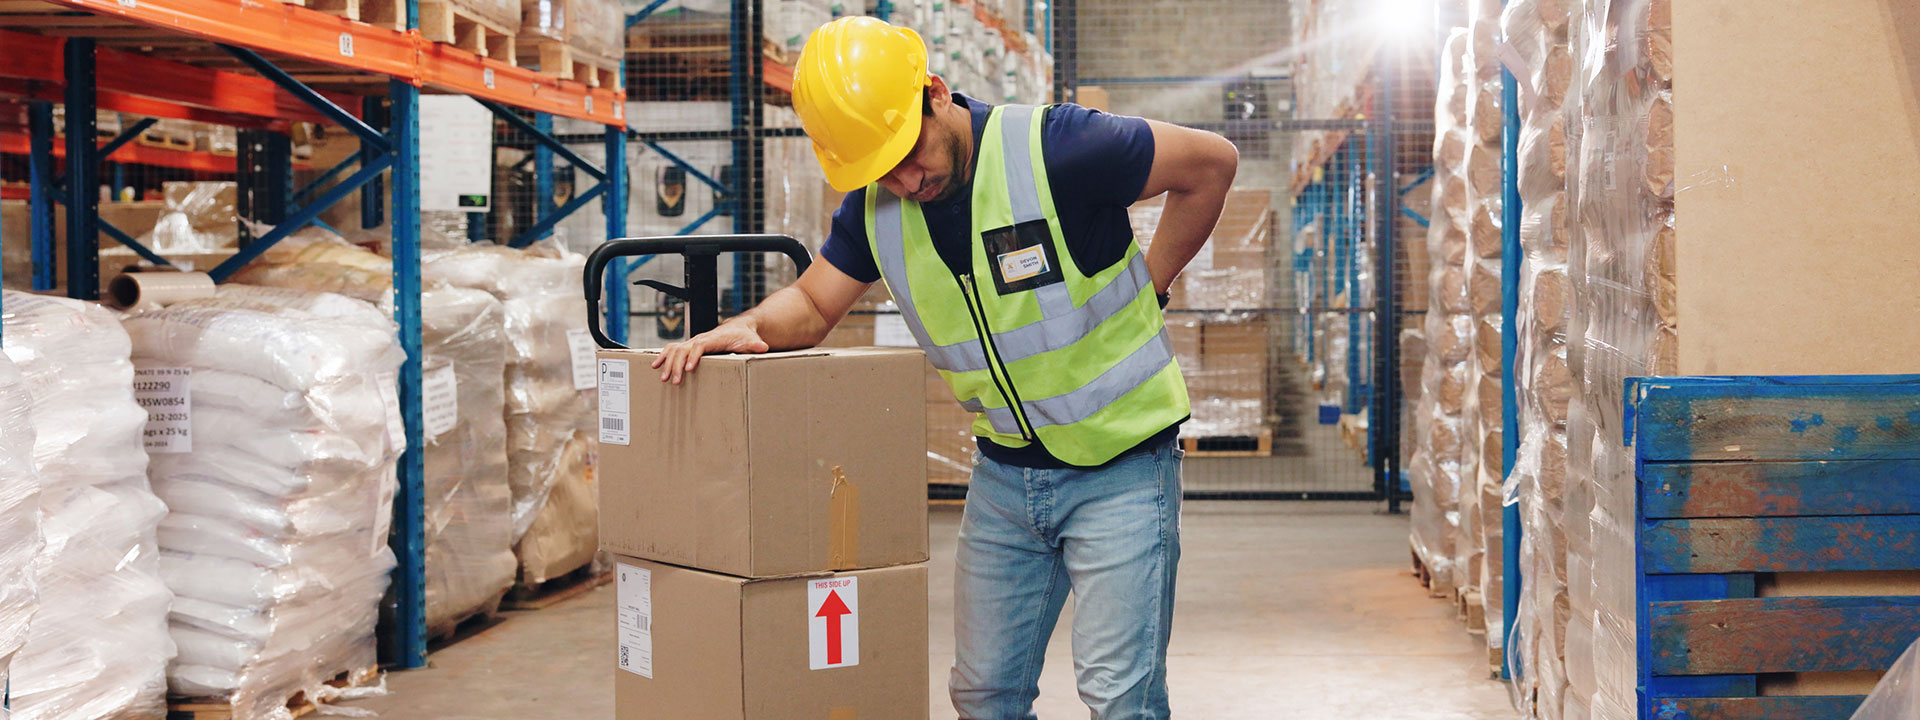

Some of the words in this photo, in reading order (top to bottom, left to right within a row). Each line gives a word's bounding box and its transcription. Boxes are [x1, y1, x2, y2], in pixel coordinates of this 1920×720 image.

[1020, 256, 1037, 264] DEVON
[166, 427, 176, 436] 25
[178, 427, 188, 436] kg
[842, 579, 851, 587] UP
